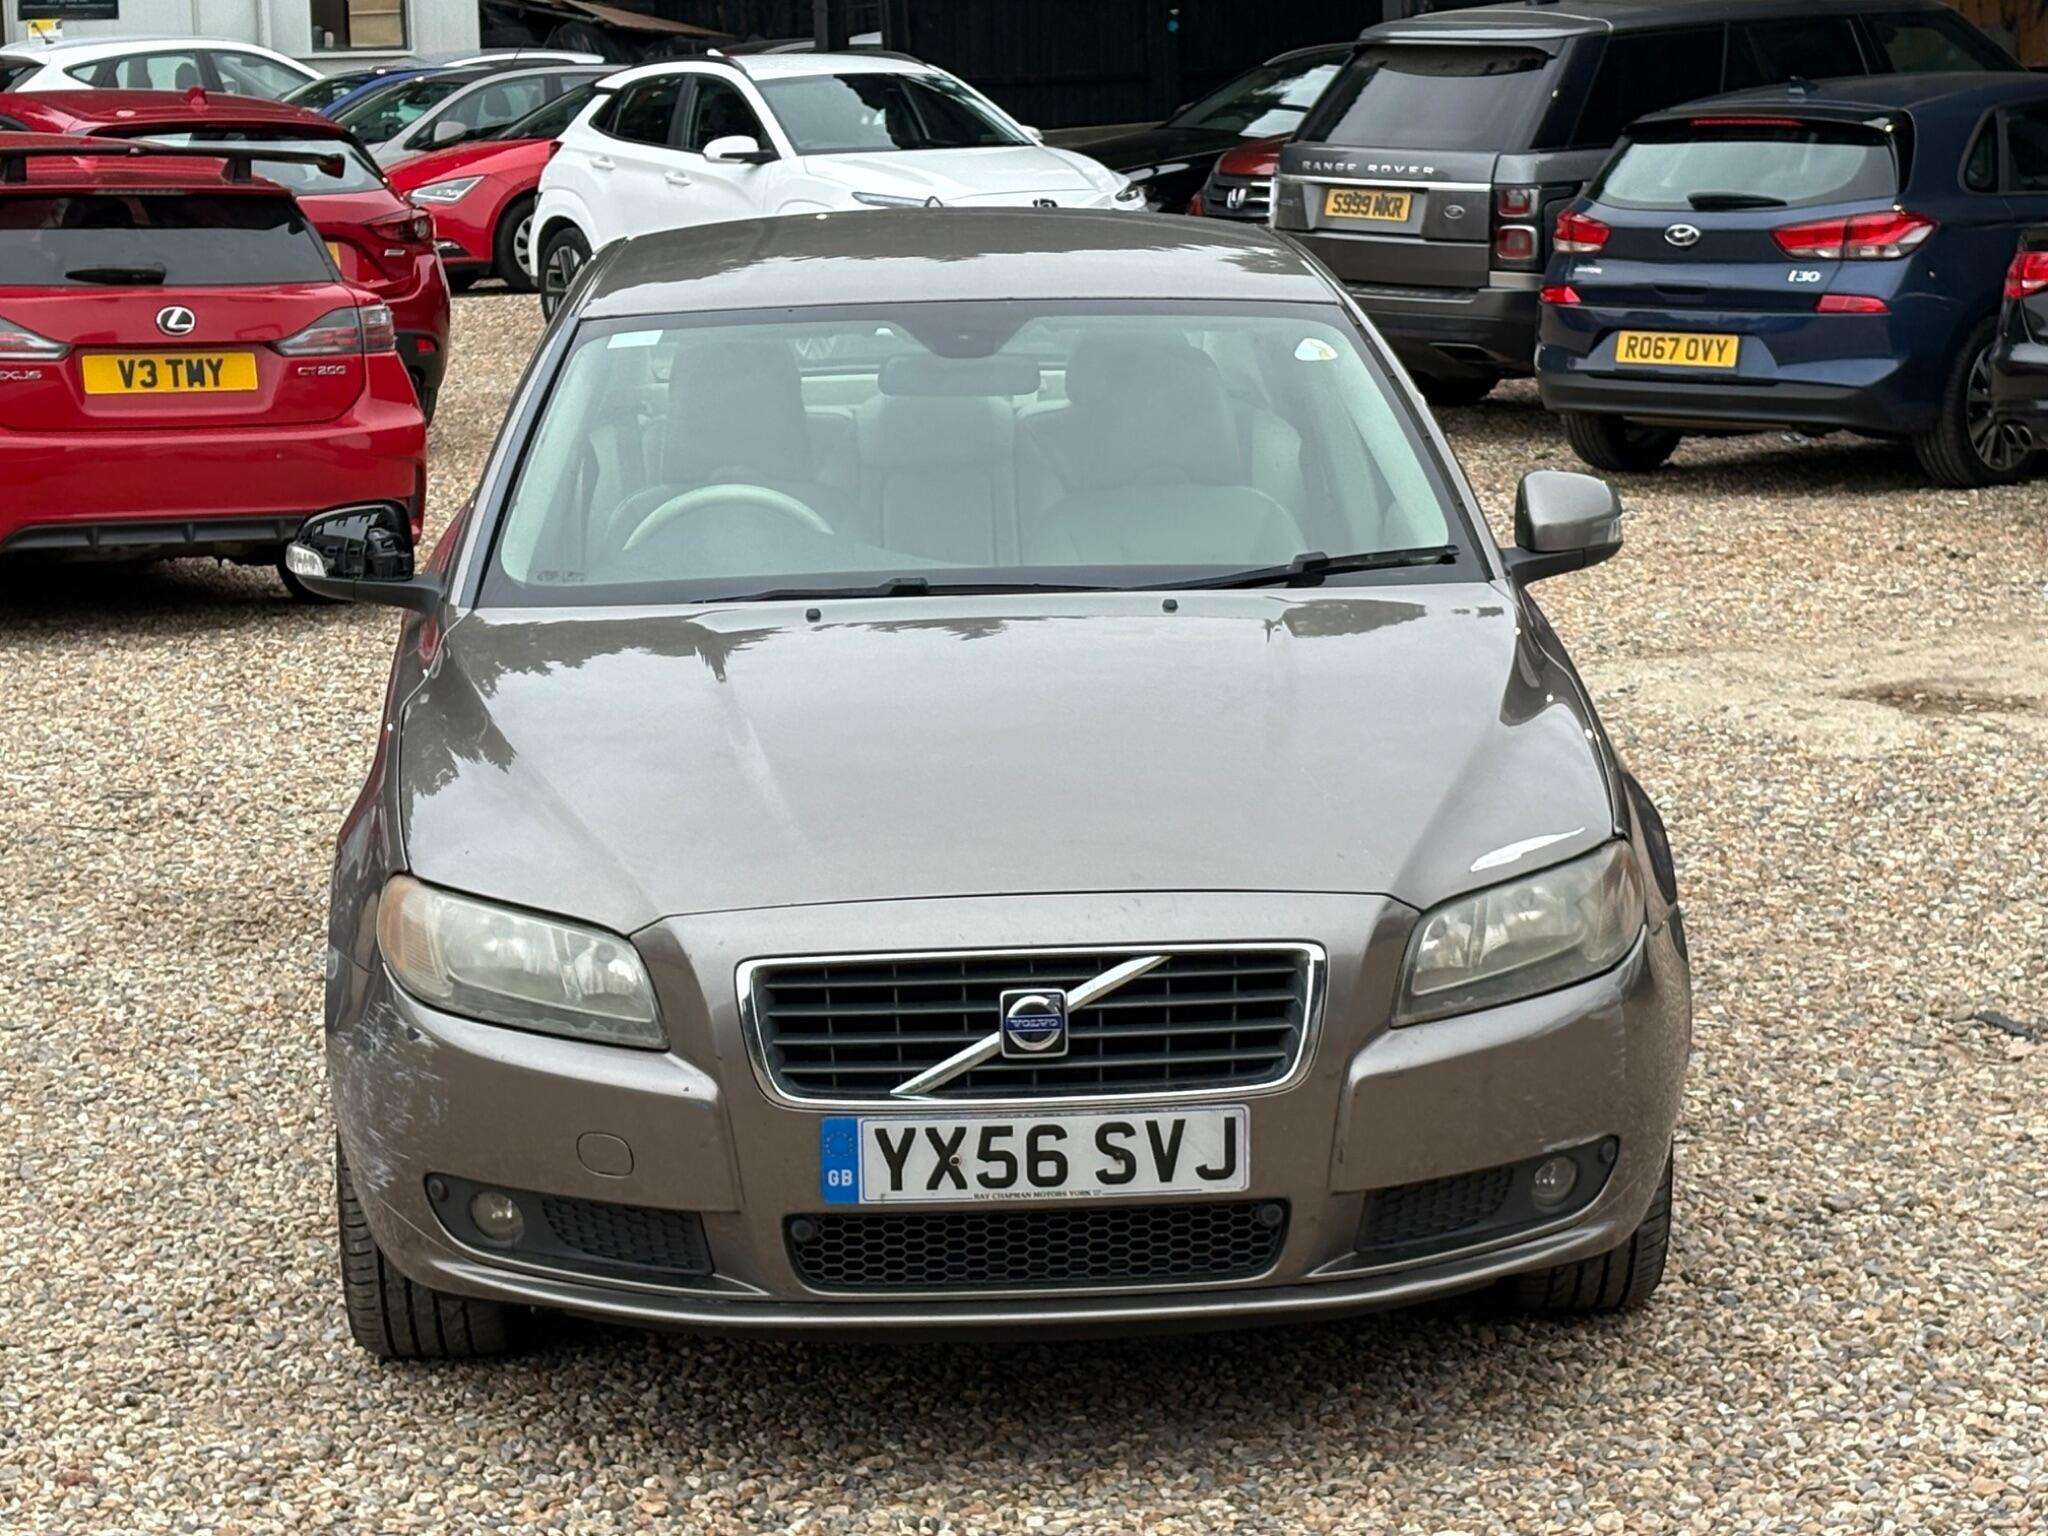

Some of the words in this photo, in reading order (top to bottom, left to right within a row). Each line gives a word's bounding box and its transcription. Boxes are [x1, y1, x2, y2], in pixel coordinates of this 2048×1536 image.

[1301, 160, 1357, 172] RANGE
[1367, 164, 1434, 174] ROVER
[1332, 192, 1372, 215] S999
[1625, 336, 1680, 360] RO67
[1685, 338, 1728, 362] OVY
[117, 359, 158, 388] V3
[1010, 1019, 1058, 1028] VOLVO
[874, 1124, 1069, 1191] YX56
[1095, 1116, 1236, 1185] SVJ
[827, 1168, 853, 1187] GB
